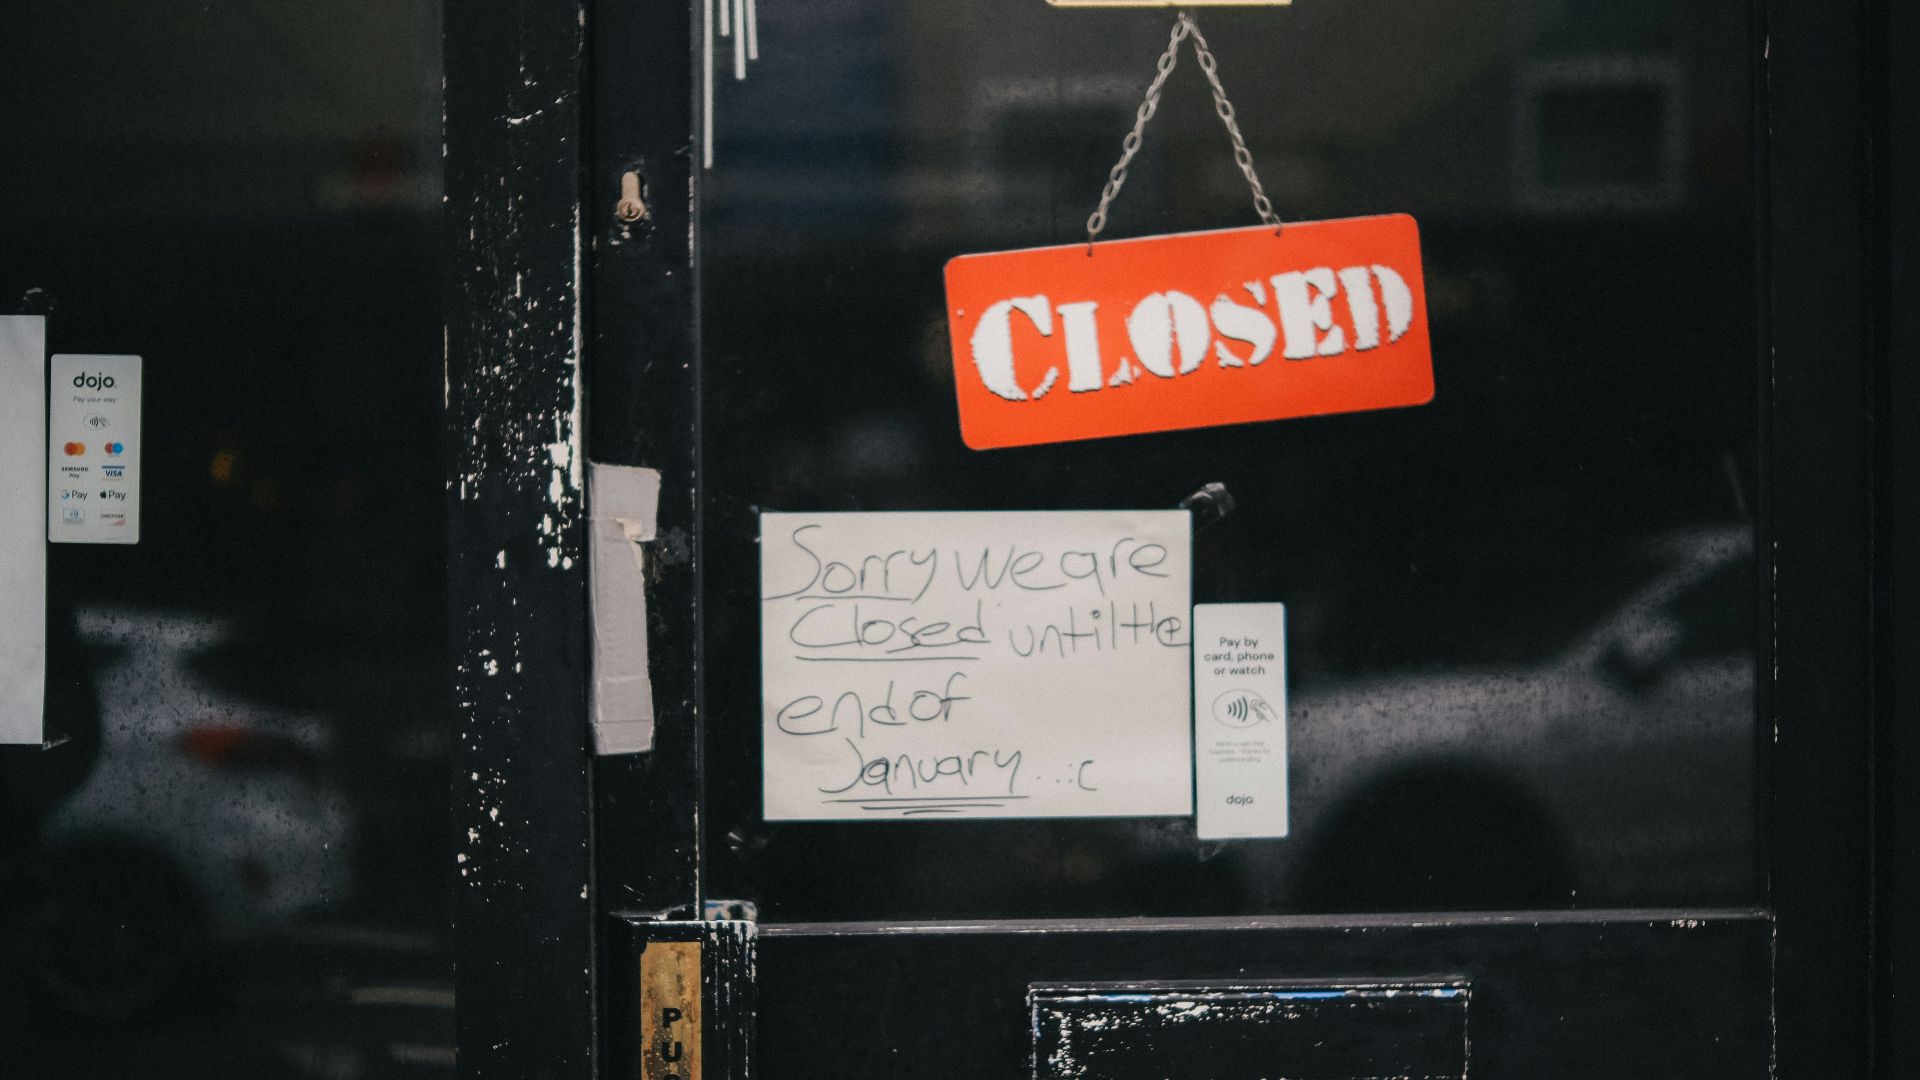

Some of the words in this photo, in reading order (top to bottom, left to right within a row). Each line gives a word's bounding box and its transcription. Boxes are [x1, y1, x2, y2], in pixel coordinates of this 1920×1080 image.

[970, 263, 1414, 402] CLOSED
[73, 372, 115, 391] dojo
[71, 490, 88, 501] Pay
[108, 489, 126, 501] Pay
[765, 524, 937, 605] Sorry
[1060, 537, 1170, 597] are
[789, 599, 993, 654] Closed
[1009, 600, 1117, 658] until
[1219, 636, 1240, 649] Pay
[1244, 637, 1259, 649] by
[1203, 651, 1234, 662] card,
[1237, 651, 1275, 663] phone
[1214, 667, 1226, 676] or
[1229, 664, 1265, 676] watch
[776, 680, 907, 739] end
[909, 671, 972, 722] of
[817, 737, 1023, 795] January
[1225, 793, 1255, 807] dojo
[661, 1007, 683, 1080] PU
